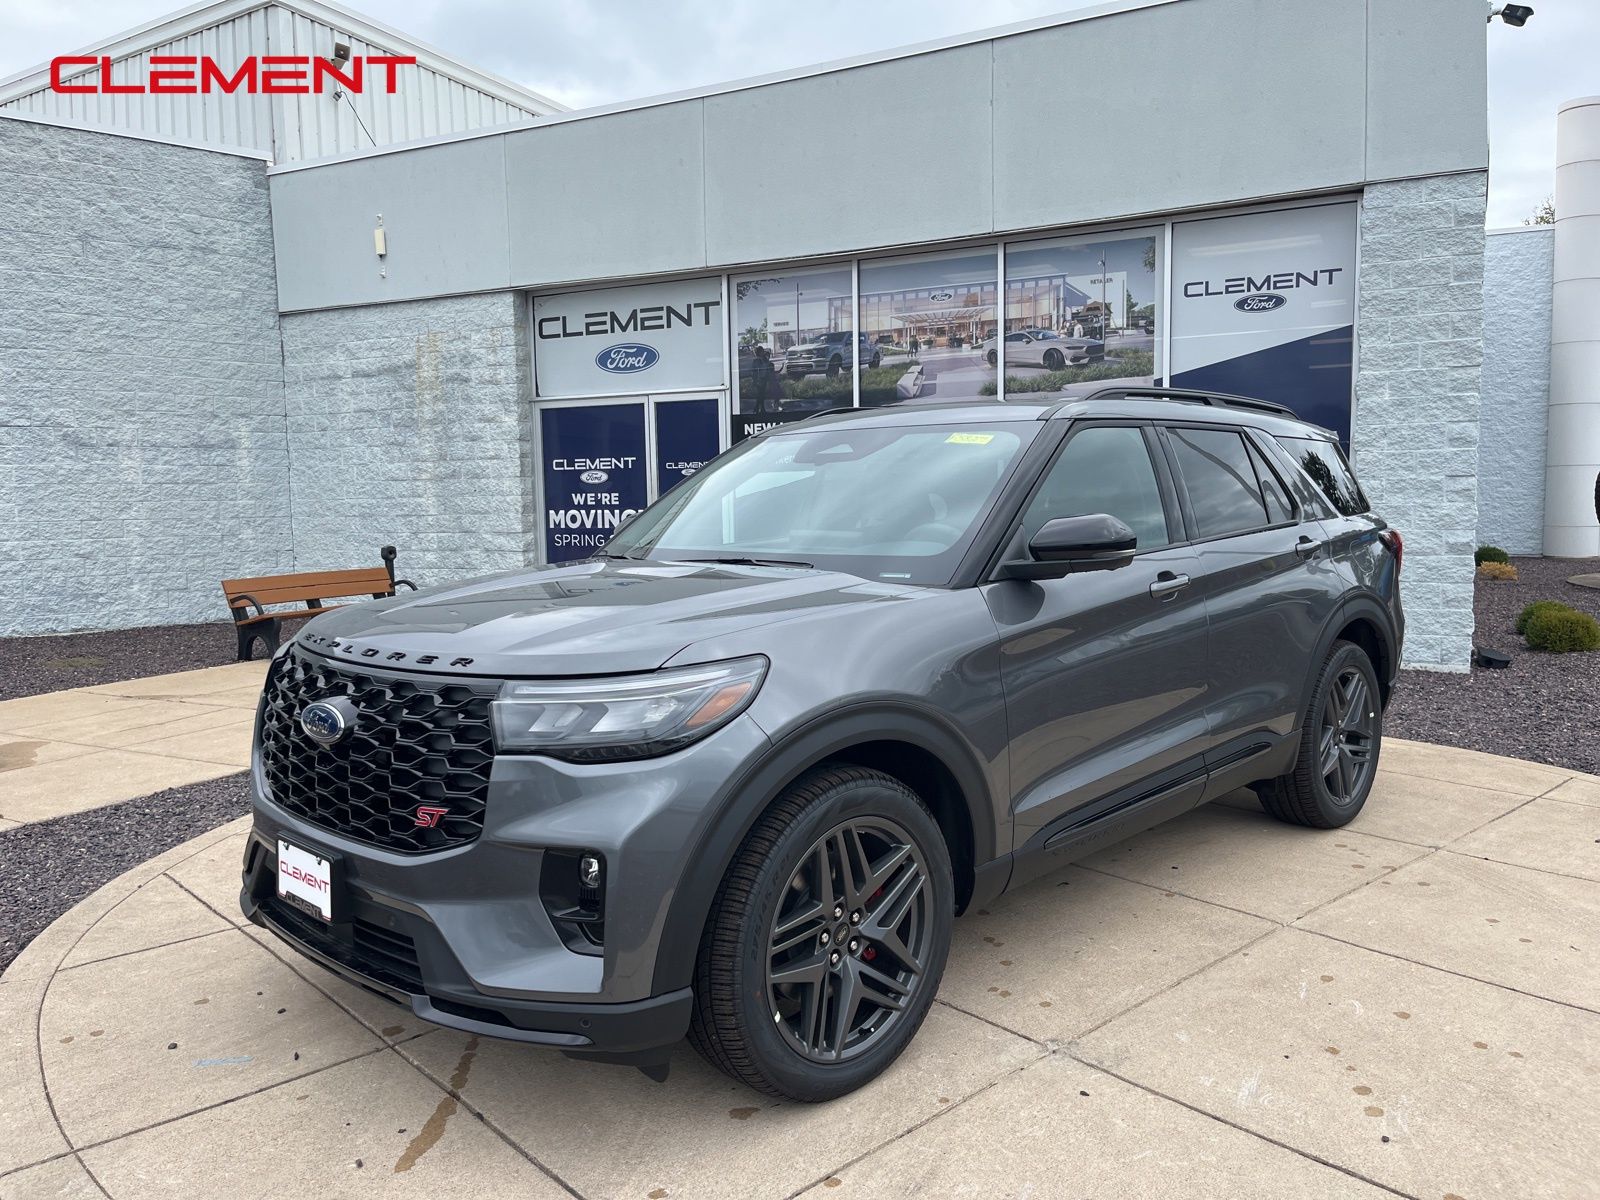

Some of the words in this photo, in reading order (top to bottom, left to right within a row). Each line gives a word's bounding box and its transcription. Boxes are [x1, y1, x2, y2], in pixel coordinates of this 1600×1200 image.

[1183, 268, 1343, 298] CLEMENT
[1244, 296, 1275, 310] Ford
[538, 301, 720, 340] CLEMENT
[606, 348, 647, 369] Ford
[552, 457, 636, 470] CLEMENT
[665, 461, 709, 469] CLEMEN
[585, 472, 603, 482] Ford
[571, 493, 619, 505] WE'RE
[554, 534, 605, 547] SPRING
[304, 633, 474, 667] EXPLORER
[414, 806, 449, 828] ST
[280, 861, 330, 894] CLEMENT
